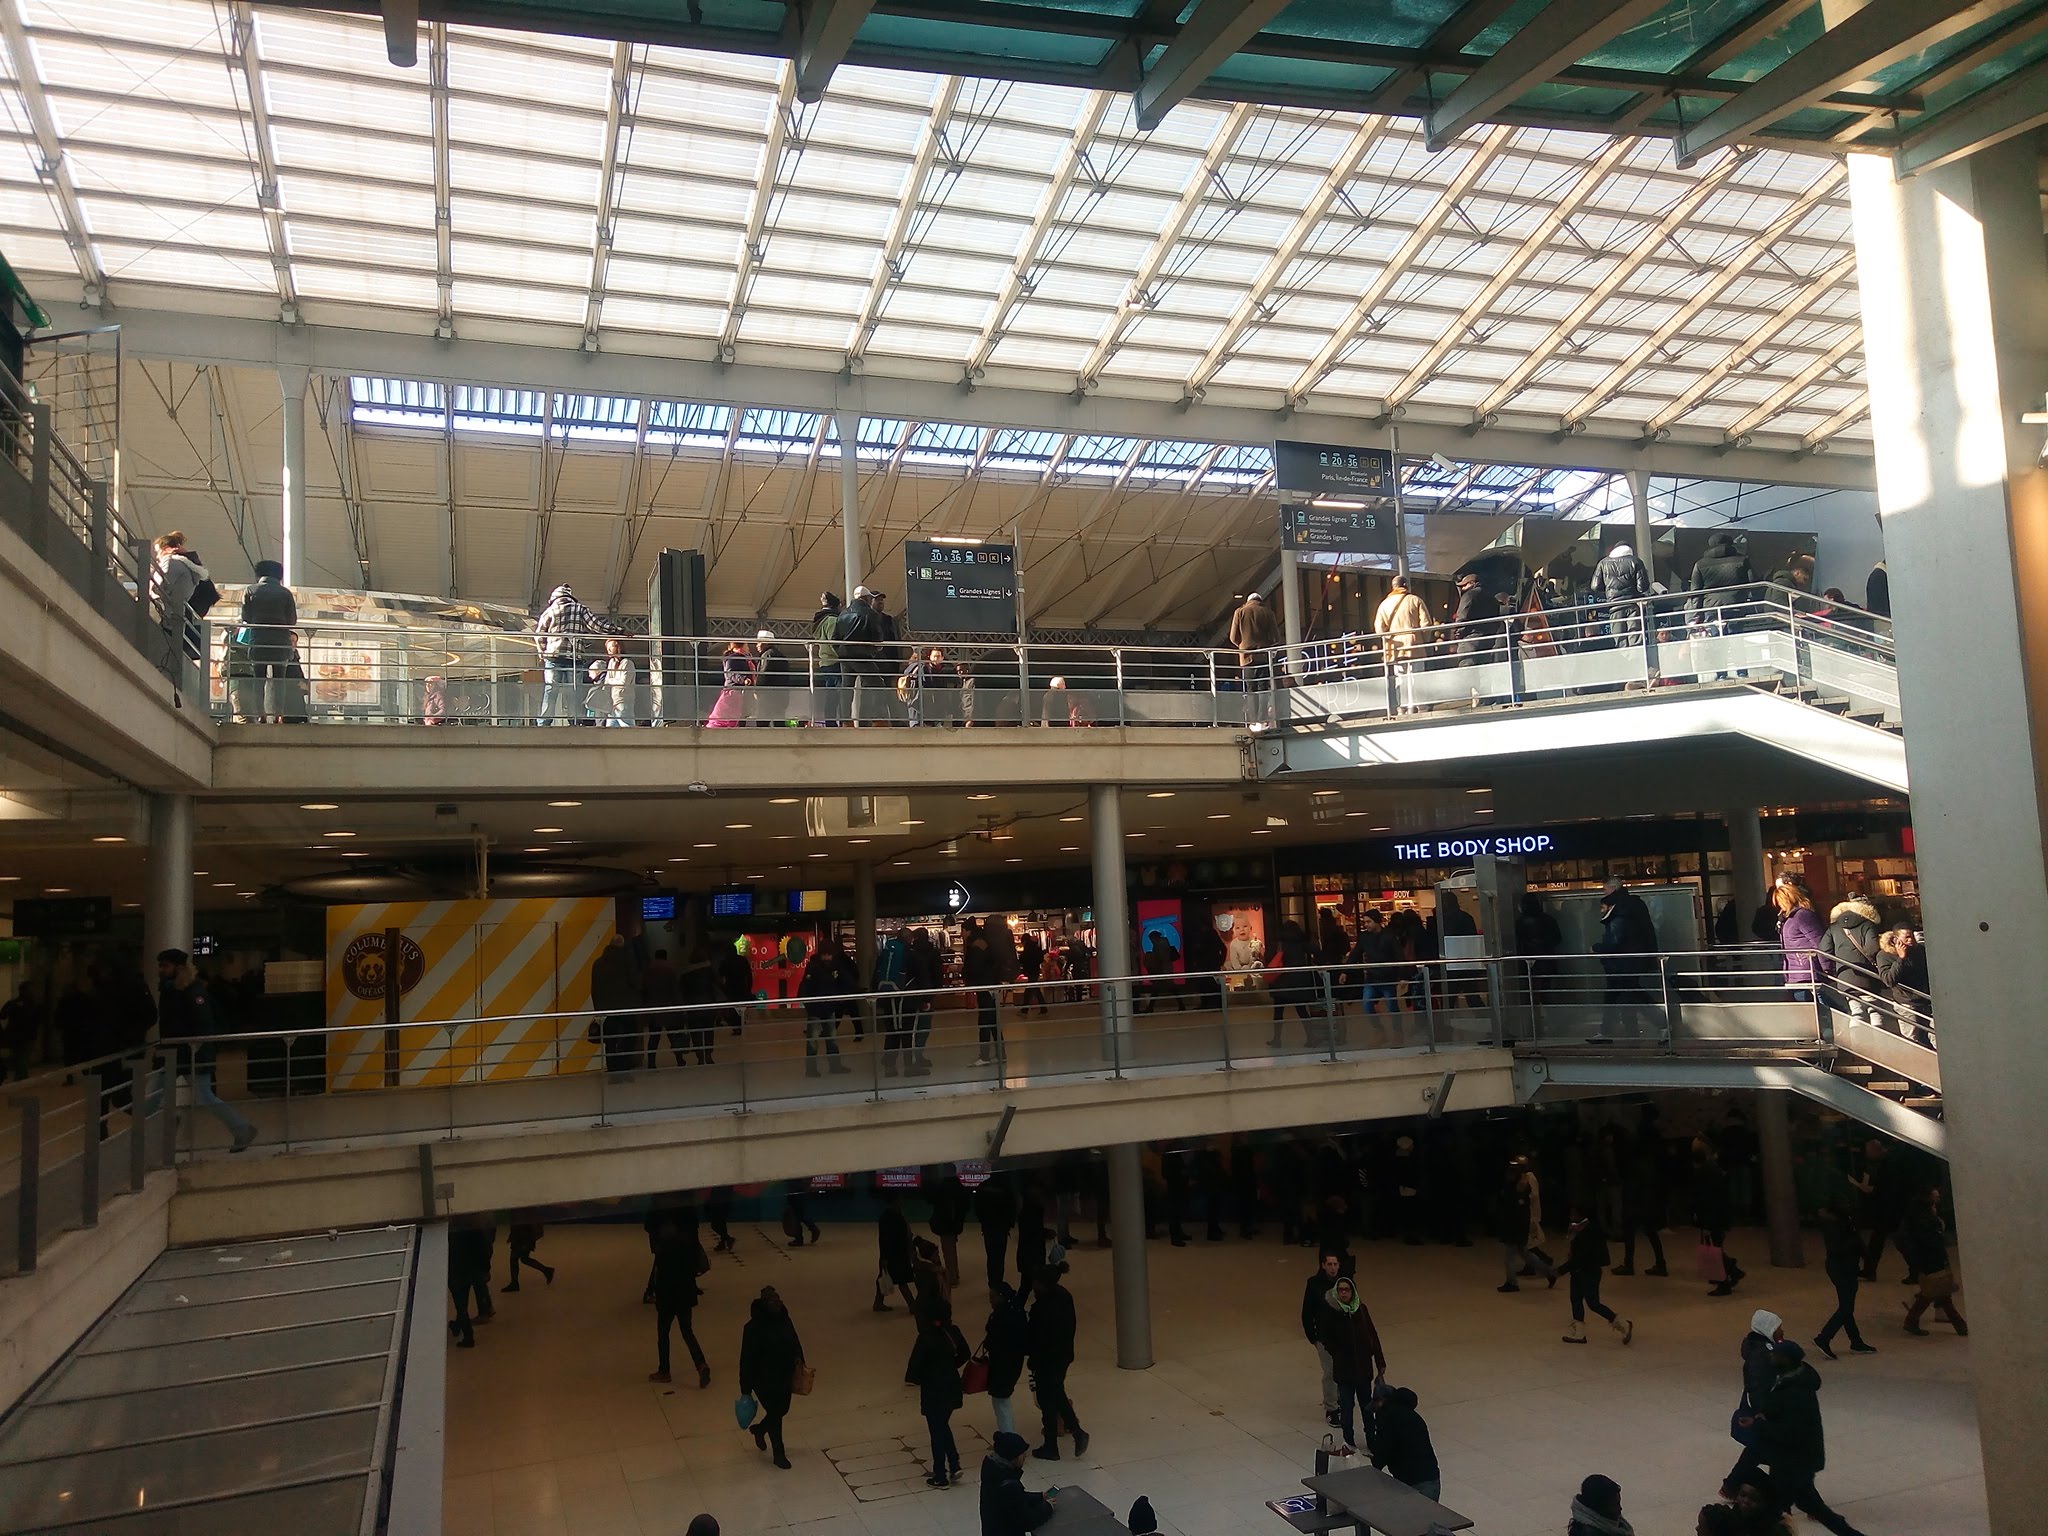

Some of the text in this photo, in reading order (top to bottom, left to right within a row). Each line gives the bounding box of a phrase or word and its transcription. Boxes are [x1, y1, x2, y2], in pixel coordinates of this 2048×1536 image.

[1332, 457, 1343, 466] 20
[1347, 458, 1358, 467] 36
[1352, 517, 1358, 526] 2
[1366, 519, 1376, 528] 19
[931, 552, 942, 561] 30
[950, 553, 961, 562] 36
[959, 587, 983, 595] Grandes
[1394, 843, 1432, 860] THE
[1437, 838, 1490, 858] BODY
